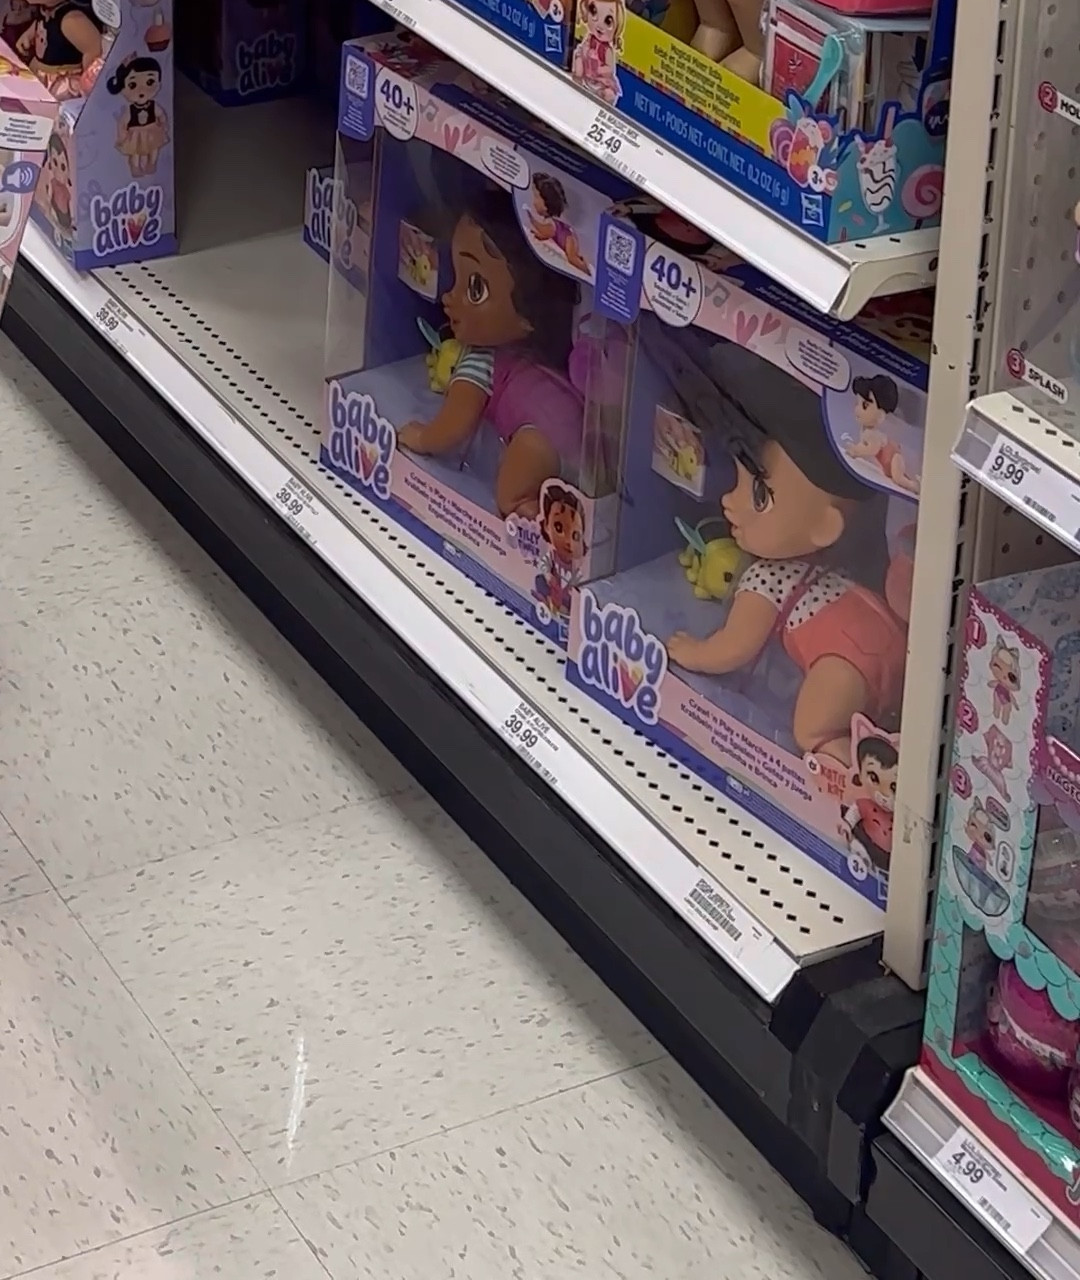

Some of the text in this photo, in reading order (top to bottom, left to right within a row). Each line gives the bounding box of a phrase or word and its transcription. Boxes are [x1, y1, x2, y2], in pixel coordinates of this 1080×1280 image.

[380, 79, 415, 116] 40+
[587, 123, 622, 154] 25.49
[634, 91, 649, 111] NET
[664, 108, 689, 139] POIDS
[689, 128, 704, 149] NET
[747, 162, 760, 185] 0.2
[760, 171, 772, 192] OZ
[811, 170, 824, 185] 3+
[92, 183, 162, 230] baby
[93, 216, 161, 256] alive
[650, 255, 697, 299] 40+
[1028, 367, 1065, 399] SPLASH
[330, 382, 395, 463] baby
[330, 428, 391, 498] alive
[991, 455, 1025, 486] 9.99
[275, 487, 304, 516] 39.99
[582, 590, 666, 672] baby
[579, 643, 658, 723] alive
[504, 714, 539, 748] 39.99
[688, 698, 710, 719] Crawl
[719, 718, 737, 737] Play
[742, 731, 768, 755] Marche
[781, 761, 806, 785] pattes
[851, 860, 865, 874] 3+
[951, 1151, 985, 1185] 4.99
